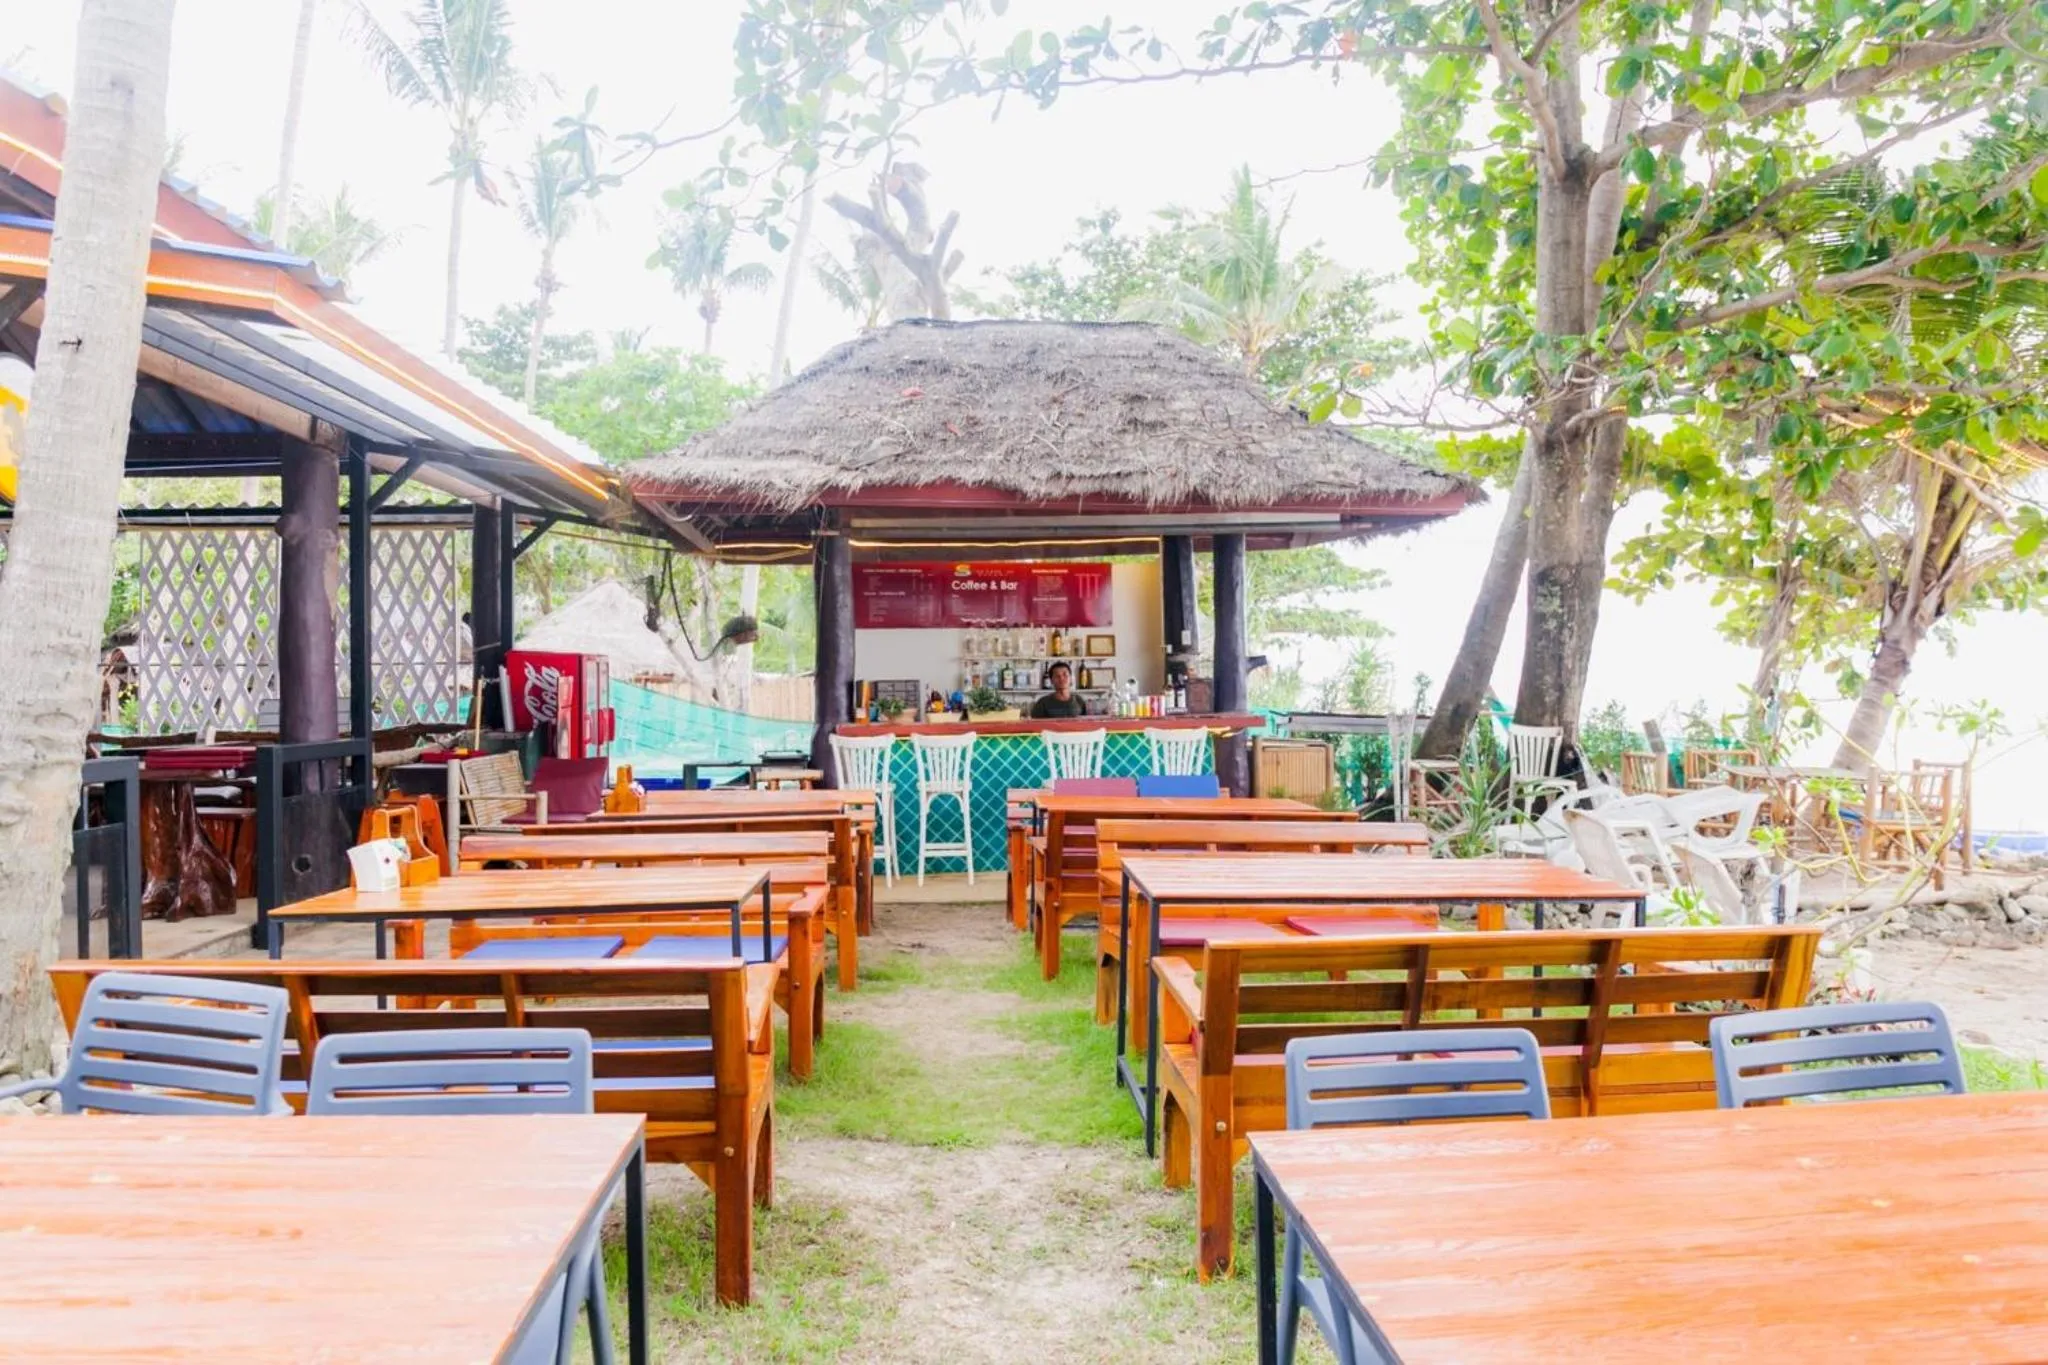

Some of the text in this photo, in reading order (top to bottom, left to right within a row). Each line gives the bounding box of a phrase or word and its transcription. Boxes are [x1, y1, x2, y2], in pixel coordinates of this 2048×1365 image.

[951, 580, 1018, 590] Coffee & Bar
